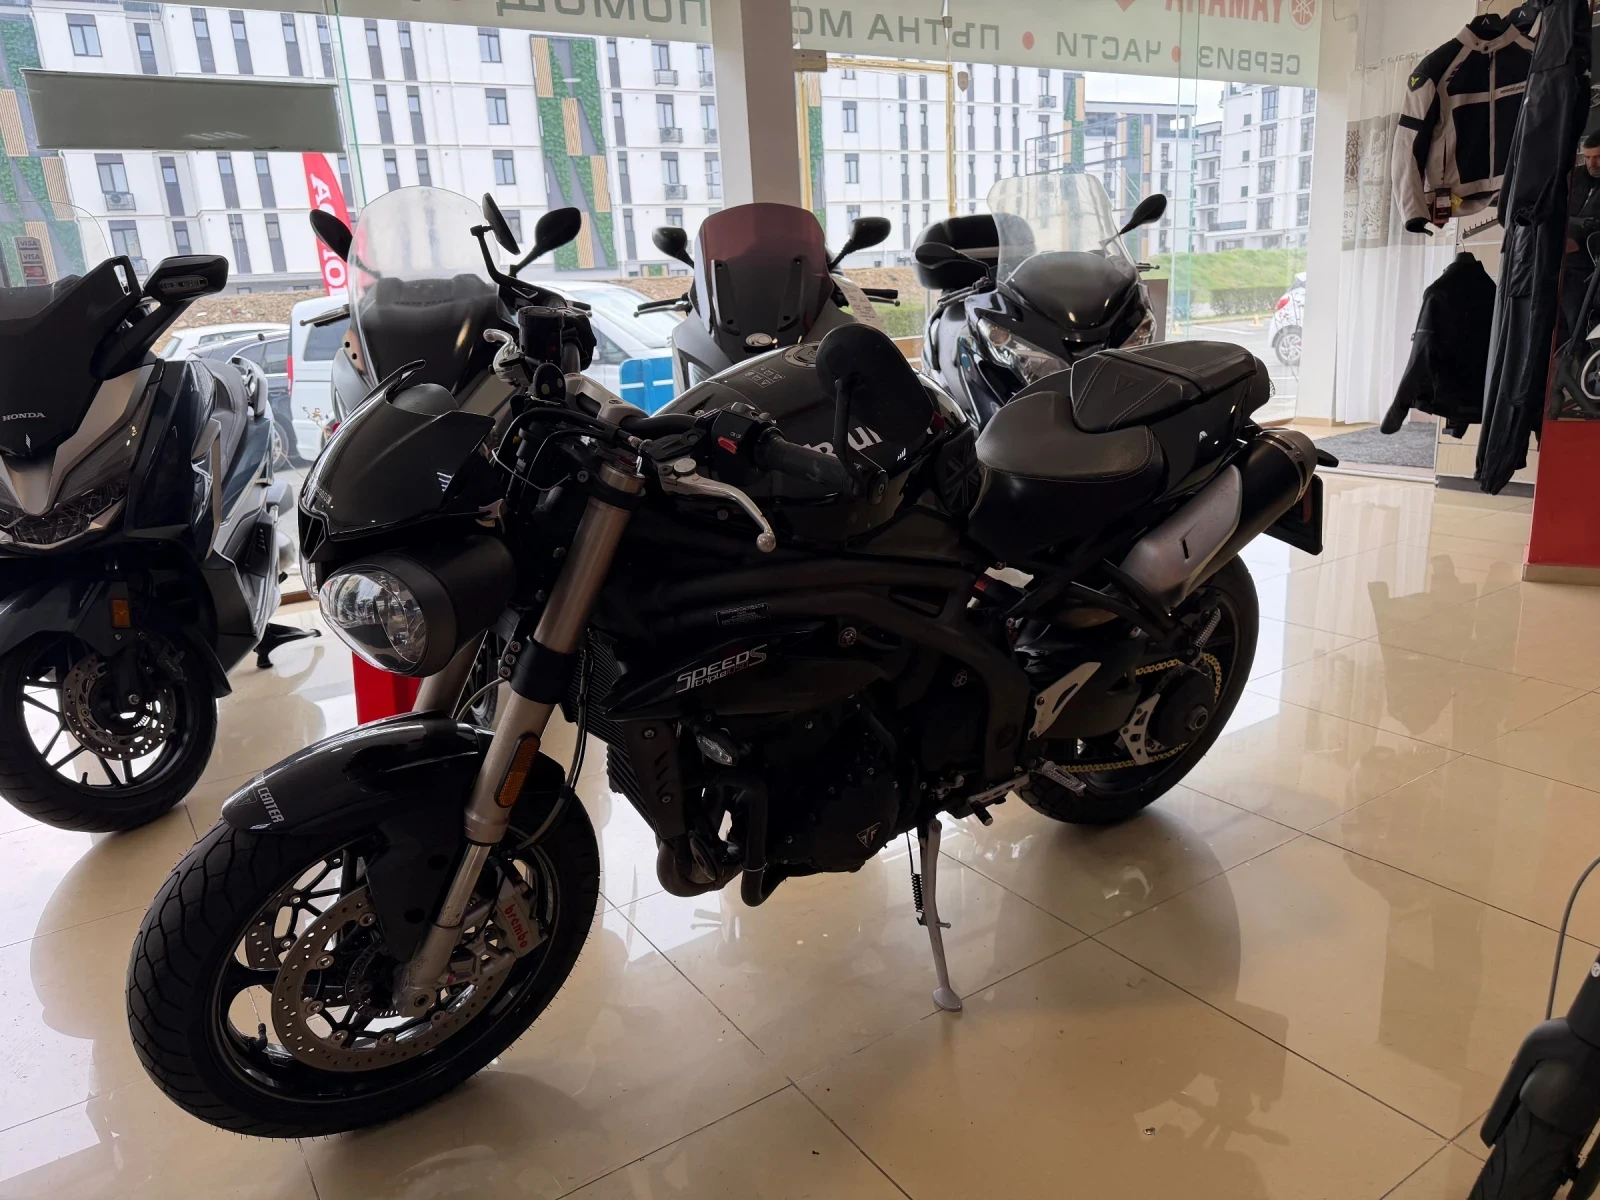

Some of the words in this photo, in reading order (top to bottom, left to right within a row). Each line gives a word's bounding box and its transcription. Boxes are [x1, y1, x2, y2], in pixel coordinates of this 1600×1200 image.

[2, 412, 46, 422] HONDA
[257, 786, 285, 824] CENTER
[504, 903, 529, 948] brembo
